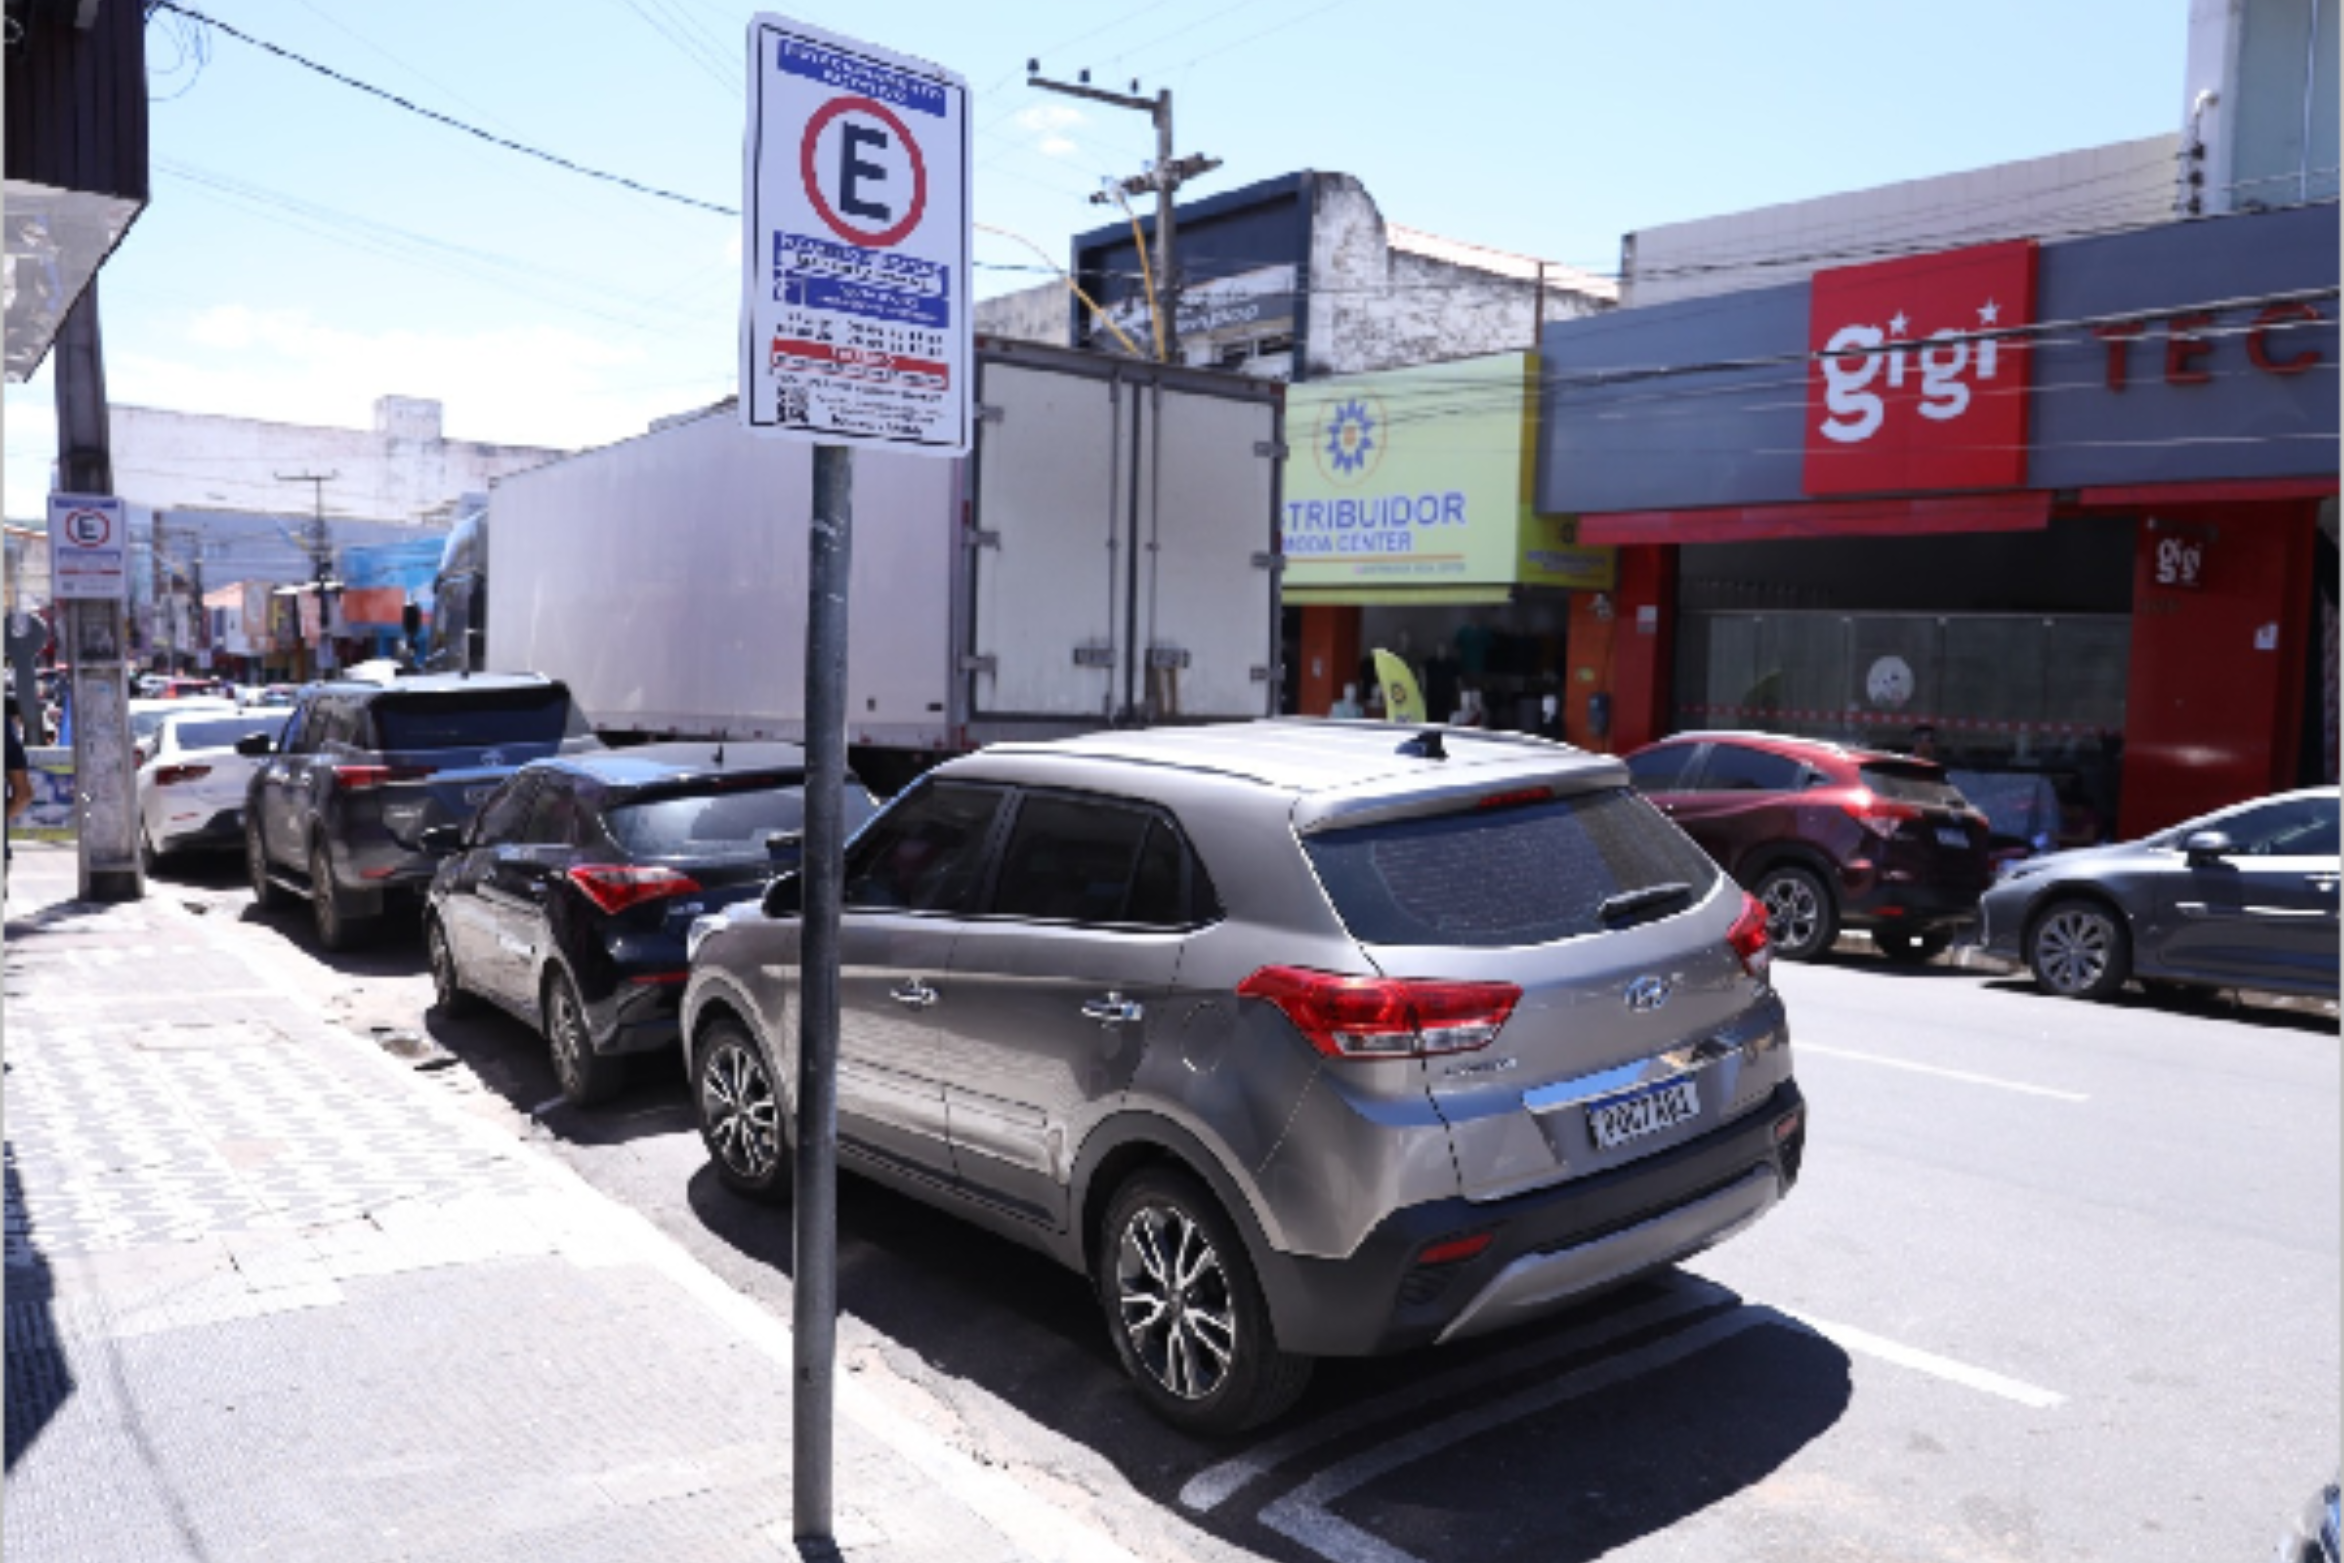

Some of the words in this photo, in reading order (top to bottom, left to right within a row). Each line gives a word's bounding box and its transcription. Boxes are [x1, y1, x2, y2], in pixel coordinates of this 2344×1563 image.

[840, 121, 891, 223] E
[1820, 297, 2001, 443] gigi
[2091, 300, 2323, 394] TEC
[79, 515, 98, 539] E
[1282, 492, 1466, 532] TRIBUIDOR
[1283, 535, 1333, 553] MODA
[1337, 530, 1412, 552] CENTER
[2156, 538, 2201, 584] gigi
